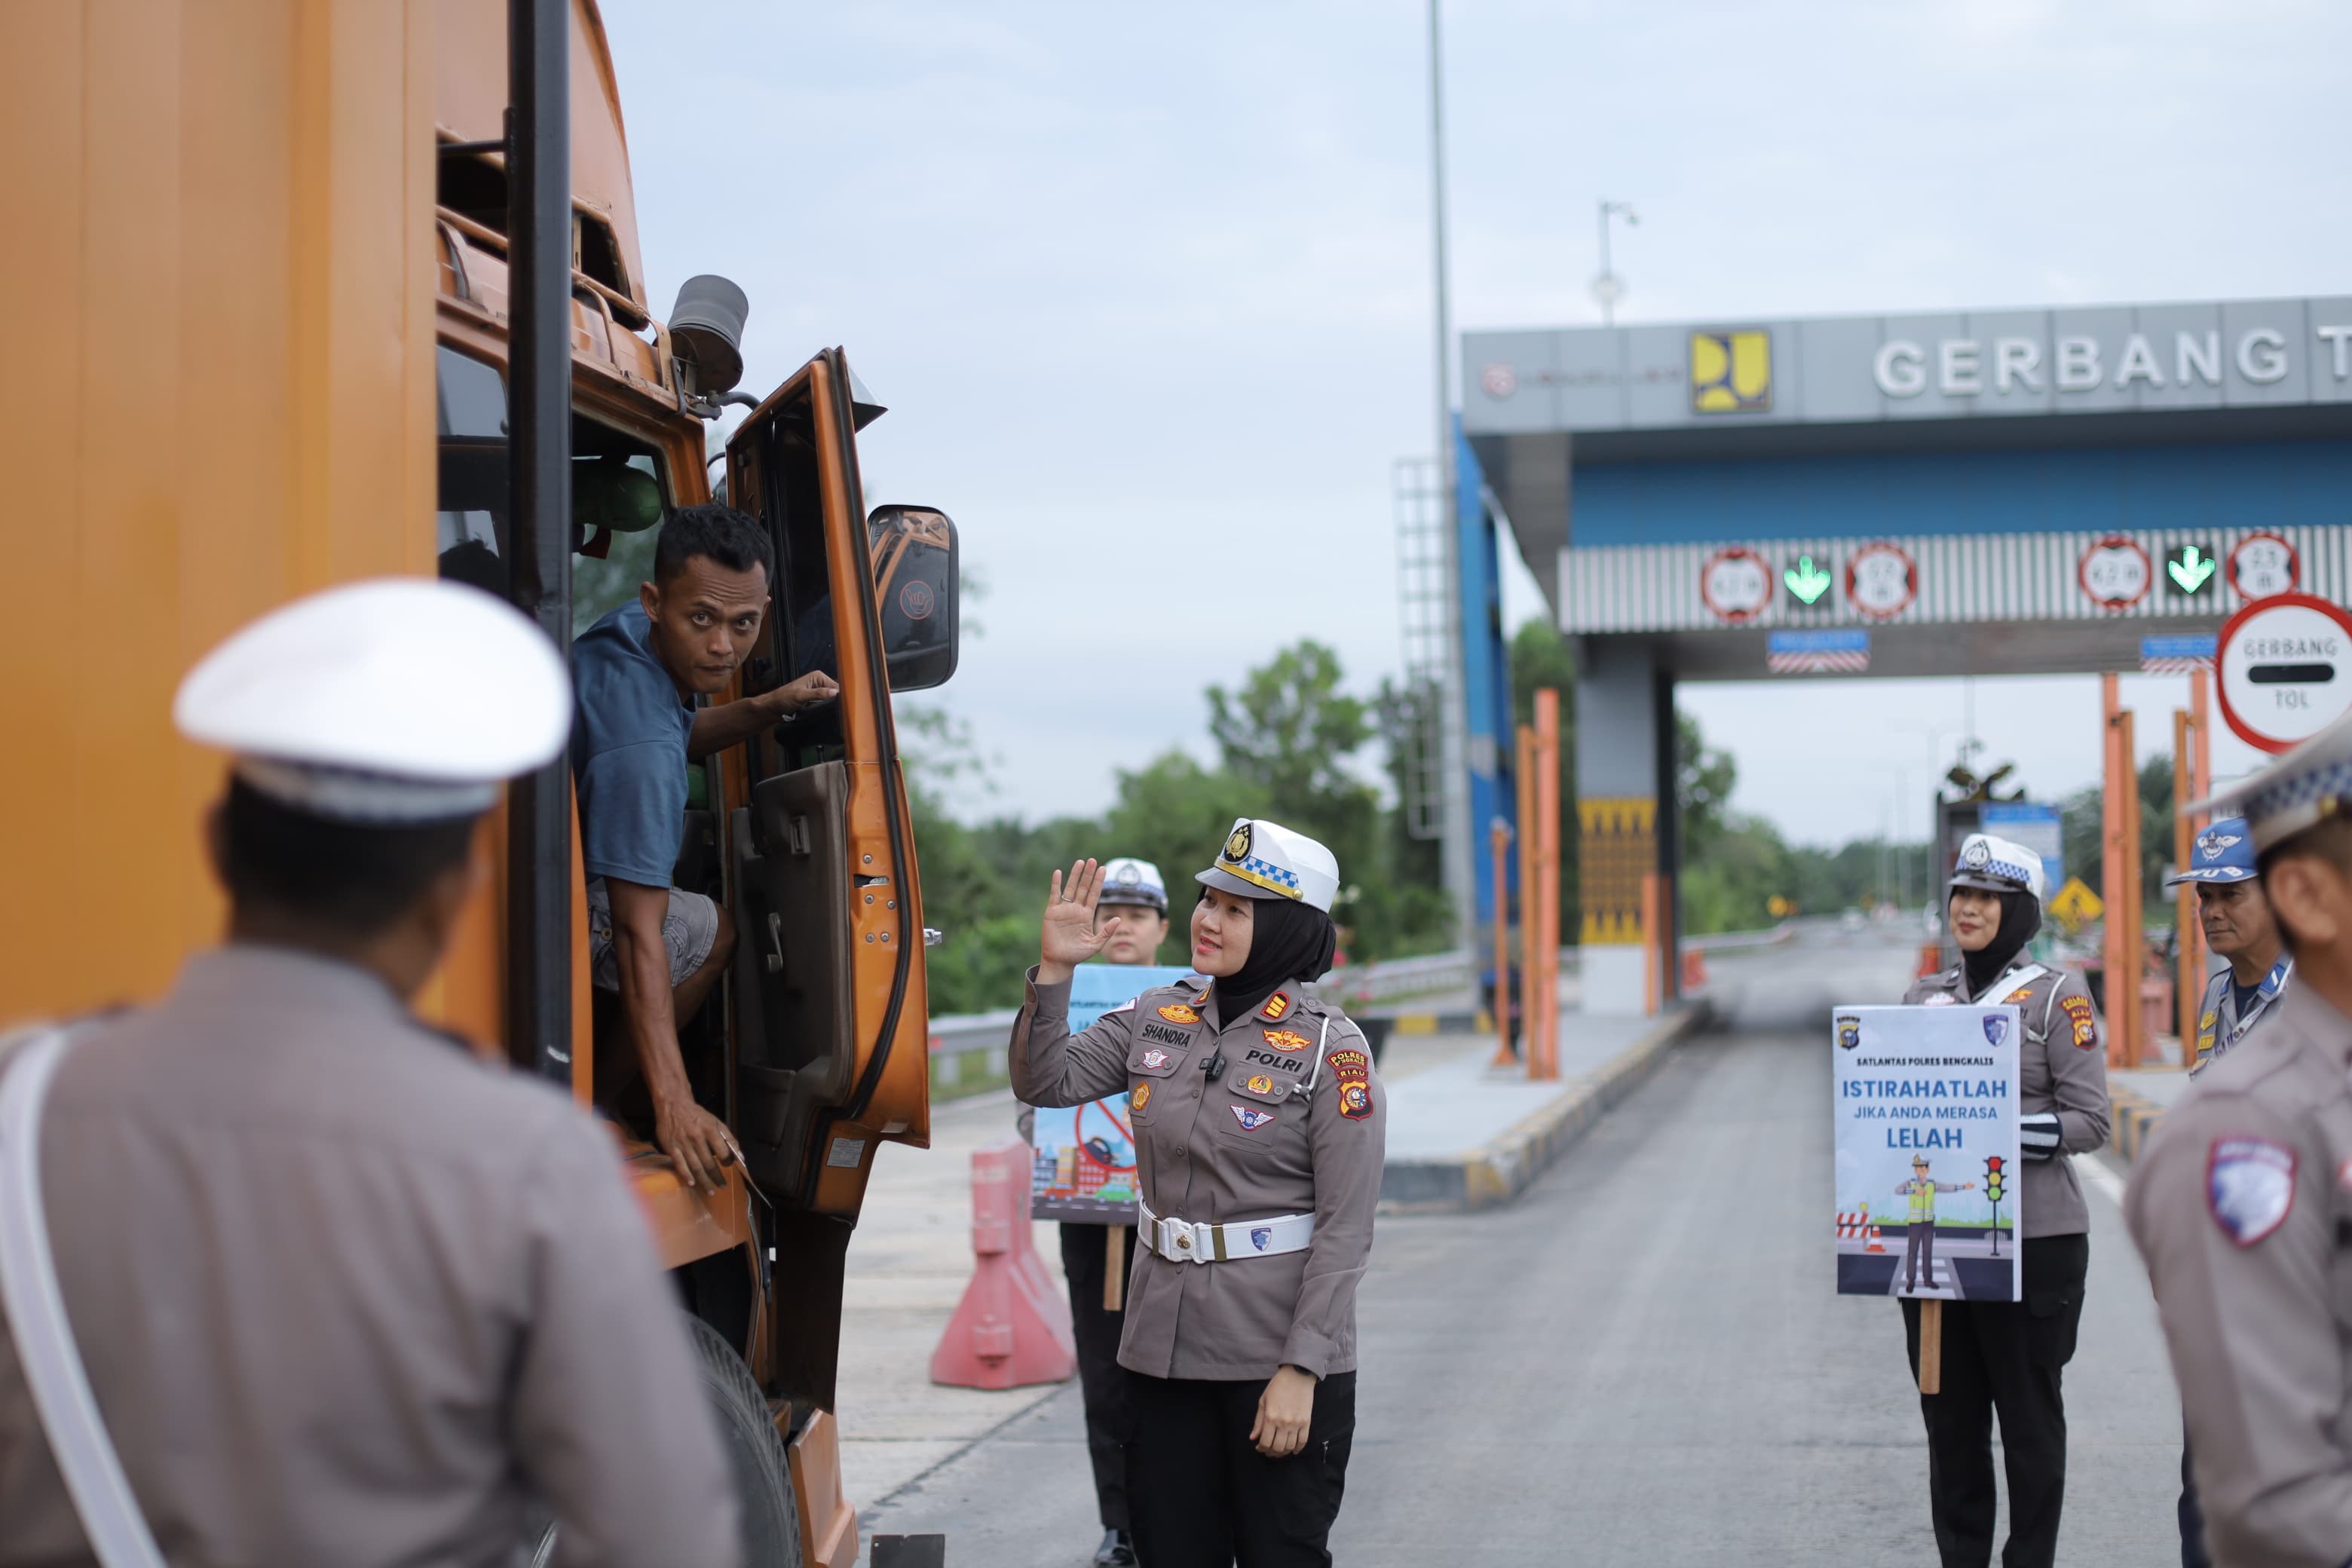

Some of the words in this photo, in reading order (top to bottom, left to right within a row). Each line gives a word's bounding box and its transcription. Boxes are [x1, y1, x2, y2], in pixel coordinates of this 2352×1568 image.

[1874, 327, 2288, 398] GERBANG
[2243, 638, 2338, 658] GERBANG
[2275, 689, 2309, 709] TOL
[1142, 1024, 1191, 1048] SHANDRA
[1245, 1049, 1303, 1073] POLRI
[1331, 1052, 1365, 1062] POLRES
[1857, 1058, 1906, 1067] SATLANTAS
[1909, 1057, 1940, 1066] POLRES
[1943, 1057, 1994, 1066] BENGKALIS
[1340, 1069, 1365, 1077] RIAU
[1843, 1080, 2007, 1098] ISTIRAHATLAH
[1854, 1107, 1887, 1119] JIKA
[1890, 1107, 1932, 1119] ANDA
[1936, 1106, 1998, 1119] MERASA
[1887, 1128, 1962, 1149] LELAH
